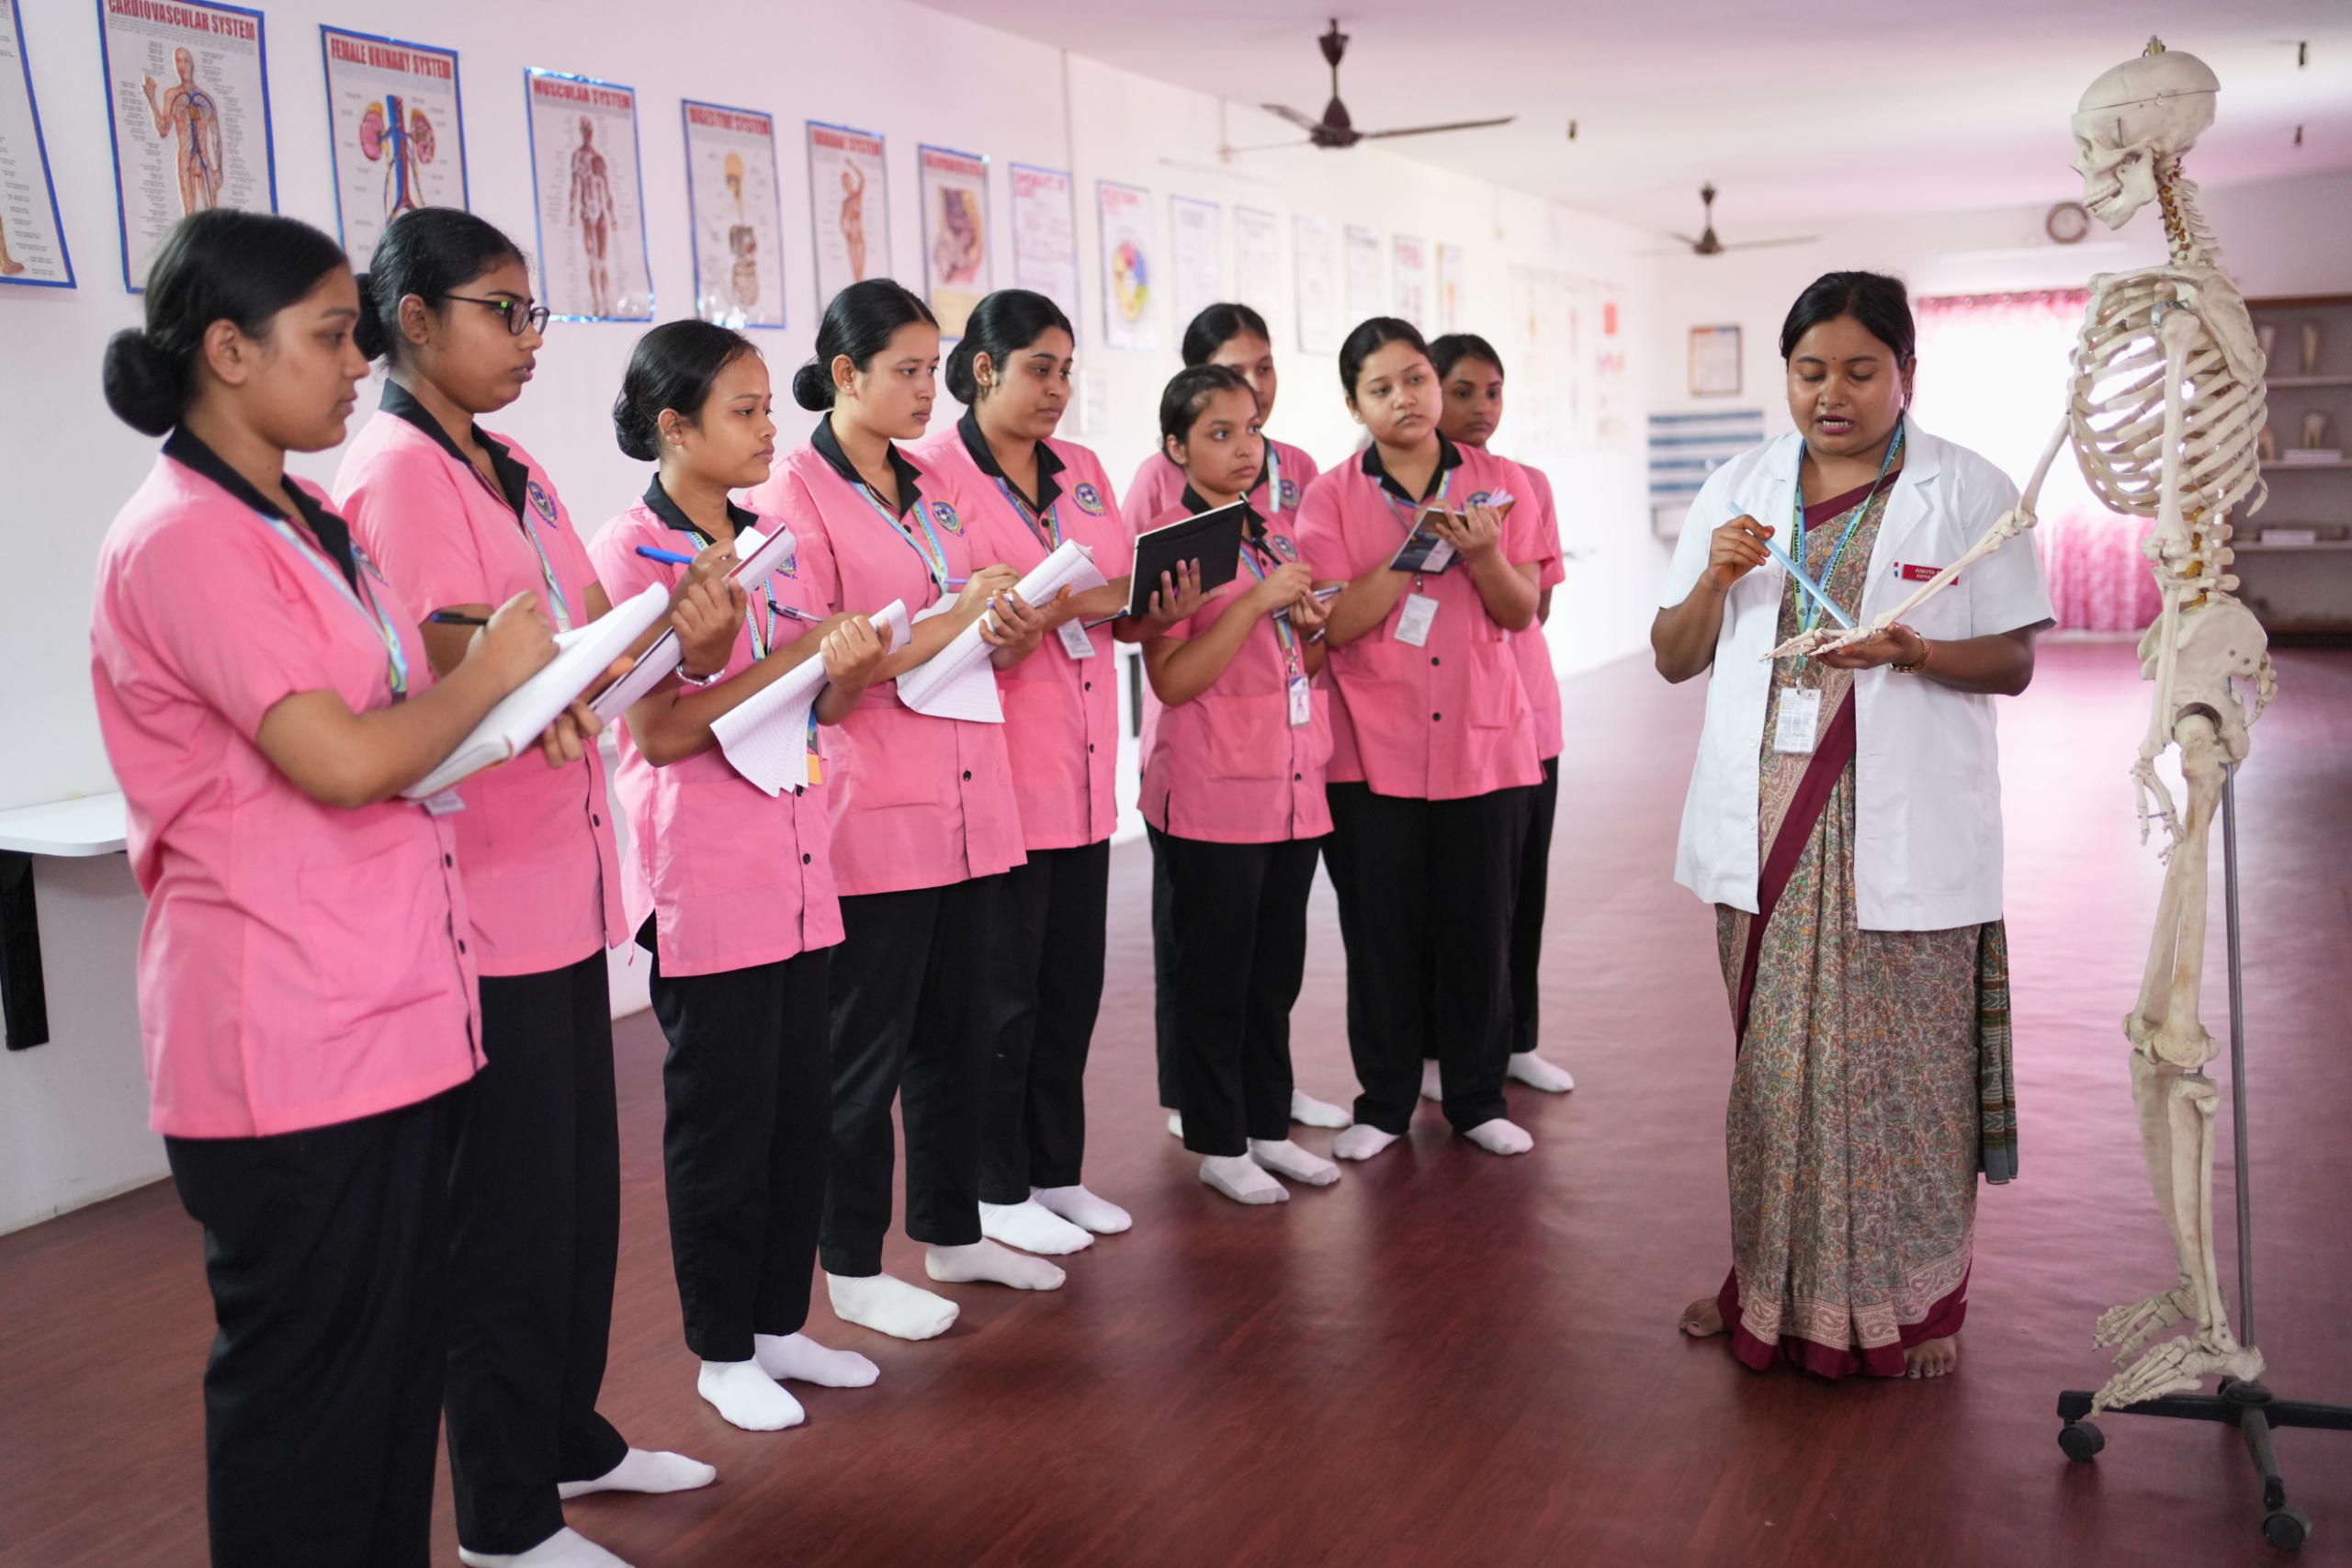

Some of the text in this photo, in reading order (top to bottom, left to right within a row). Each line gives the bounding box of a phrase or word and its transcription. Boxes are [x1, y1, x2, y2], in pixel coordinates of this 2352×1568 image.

[108, 0, 255, 40] CARDIOVASCULAR SYSTEM
[331, 38, 452, 80] FEMALE URINARY SYSTEM
[533, 79, 631, 109] MUSCULAR SYSTEM
[689, 529, 708, 551] SPITAL
[916, 510, 940, 557] DISPUR HOSPITALS
[1823, 523, 1857, 592] DISPUR HOSPITALS
[1915, 568, 1936, 576] ANKITA
[746, 607, 760, 642] OSPITALS
